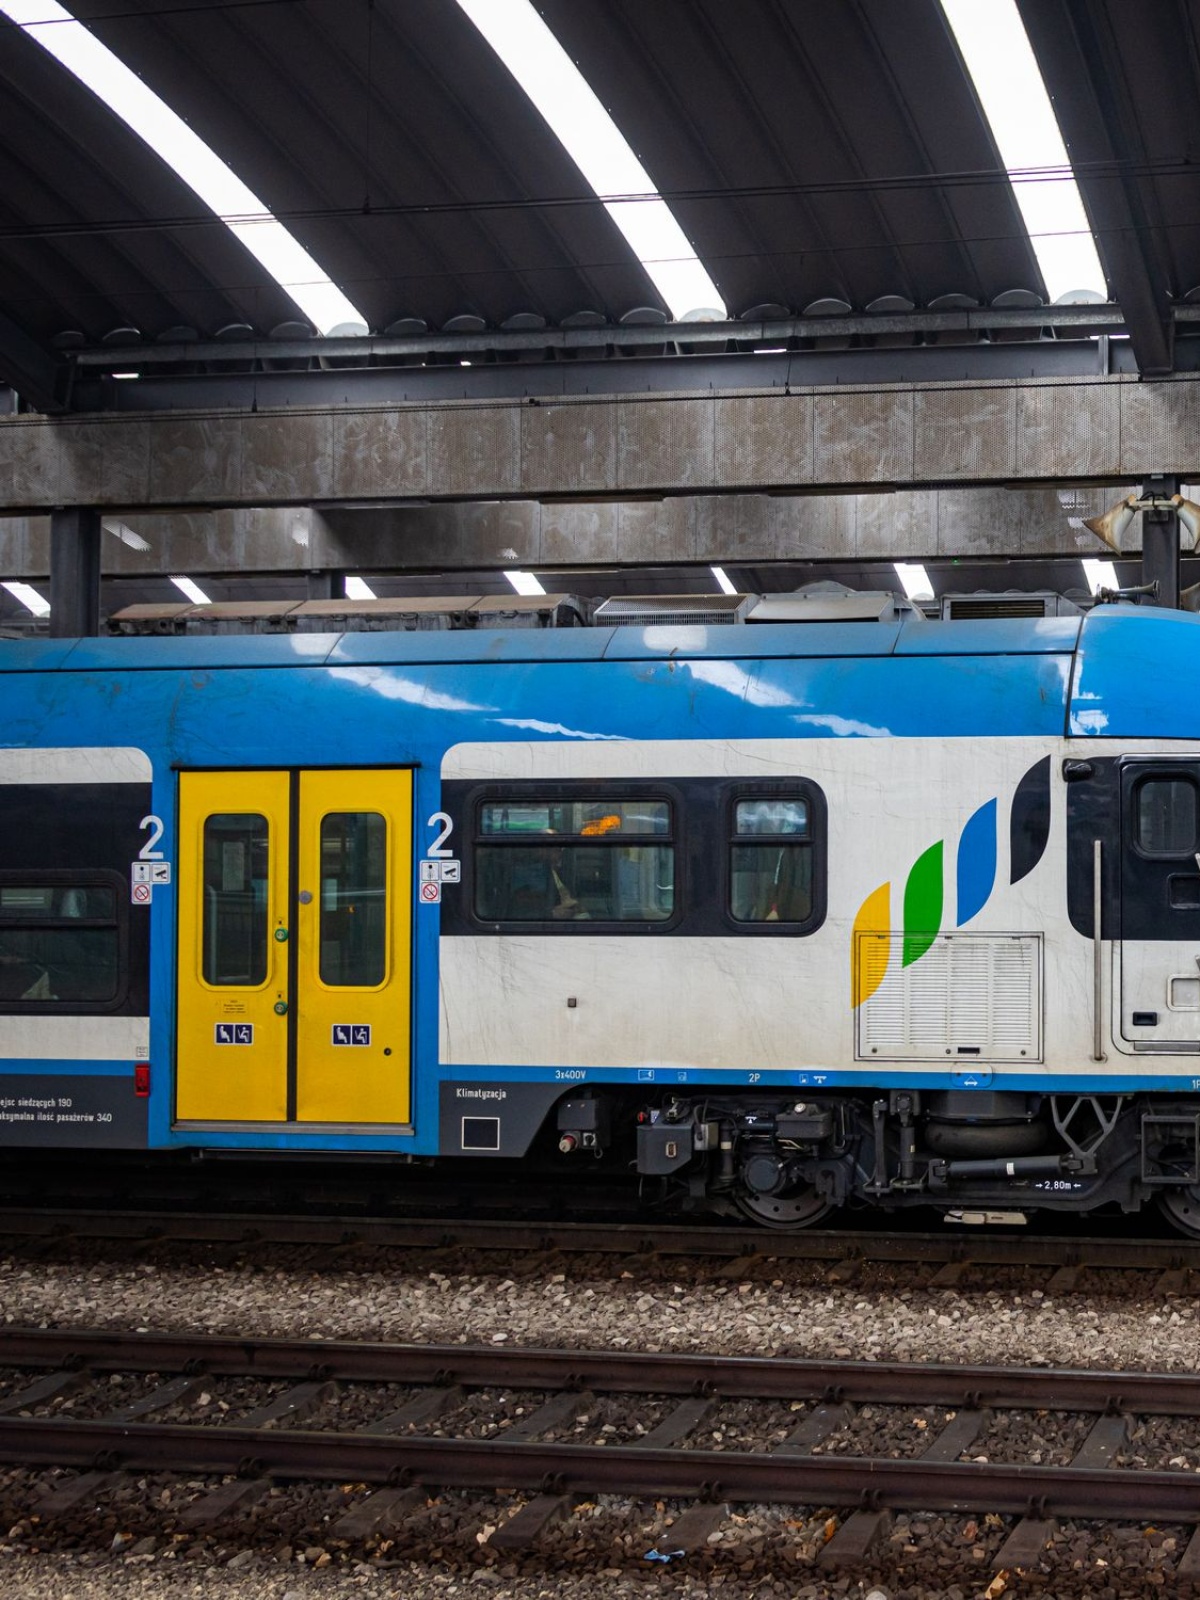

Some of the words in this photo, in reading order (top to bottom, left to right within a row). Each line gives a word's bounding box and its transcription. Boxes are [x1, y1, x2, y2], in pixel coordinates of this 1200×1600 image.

[139, 815, 164, 860] 2
[427, 812, 454, 858] 2
[555, 1070, 586, 1080] 3x400V
[748, 1072, 761, 1083] 2P
[456, 1088, 507, 1100] Klimatyzacja
[58, 1098, 72, 1107] 190
[96, 1112, 112, 1122] 340
[1044, 1180, 1072, 1190] 2,80m
